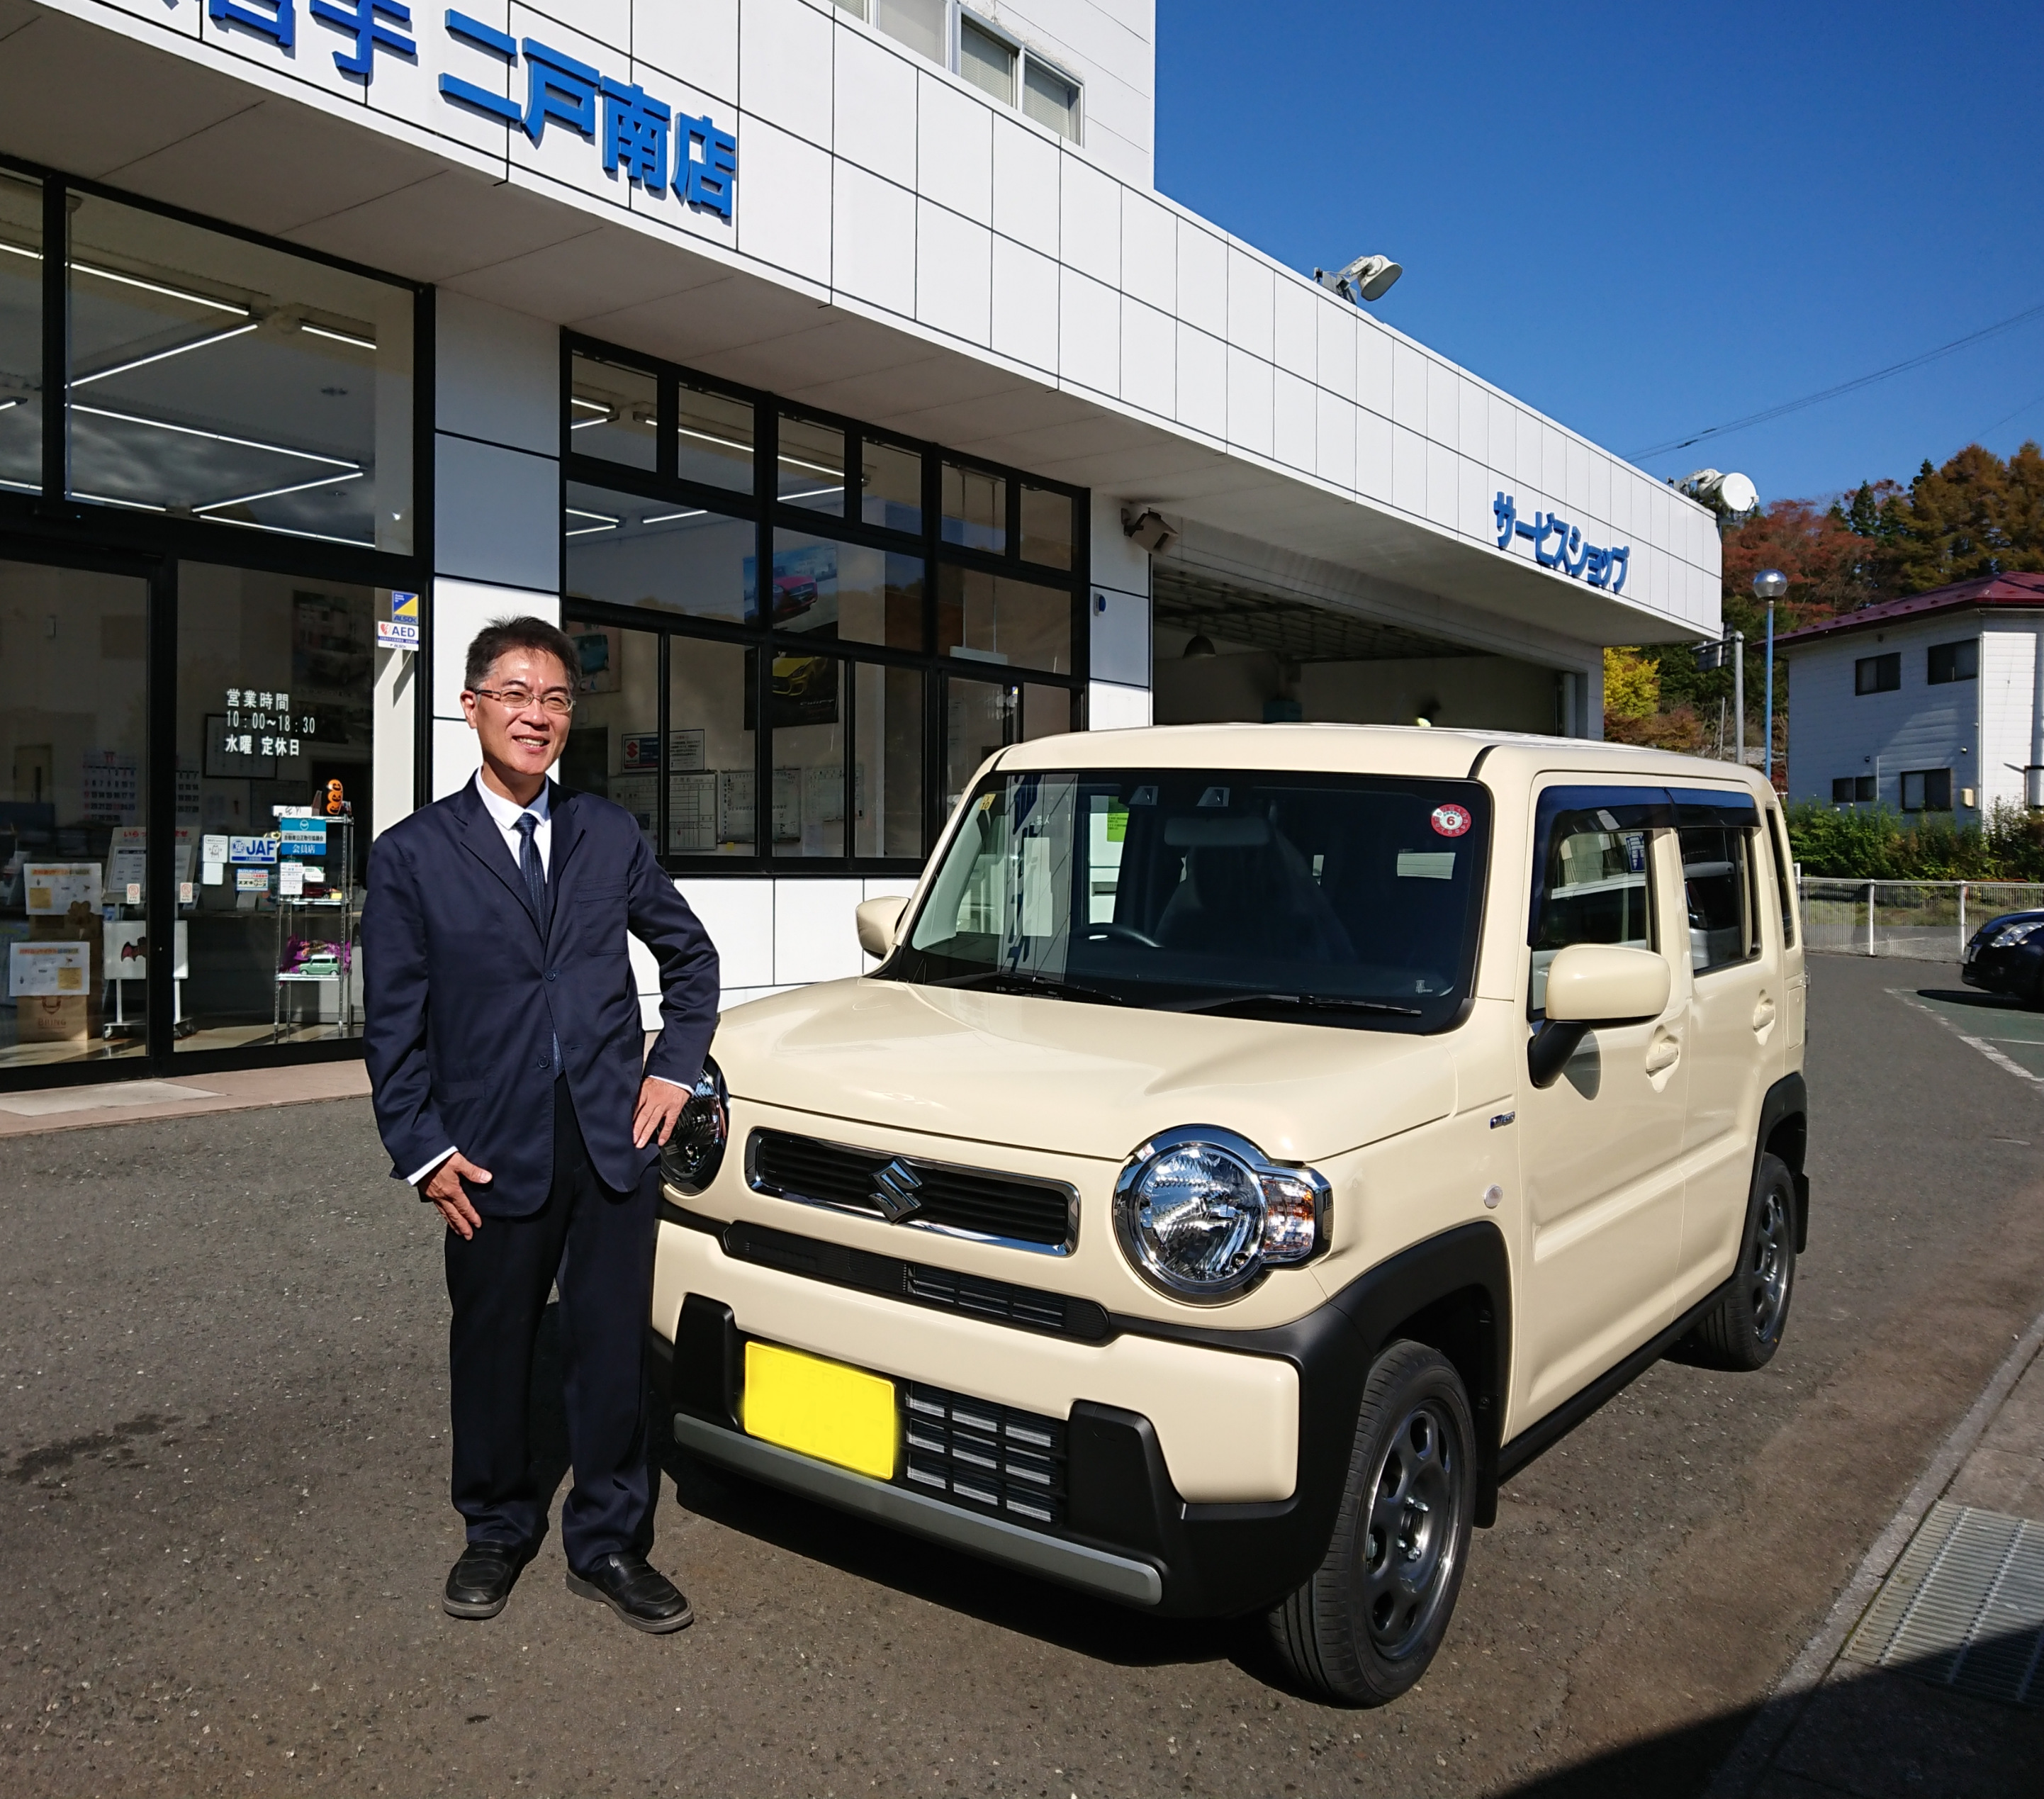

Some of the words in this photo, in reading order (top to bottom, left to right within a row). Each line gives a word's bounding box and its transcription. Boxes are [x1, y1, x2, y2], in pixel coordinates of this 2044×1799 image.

[1493, 491, 1629, 595] サービスショップ
[392, 626, 415, 637] AED
[227, 688, 288, 711] 営業時間
[225, 734, 252, 755] 水曜
[261, 736, 299, 756] 定休日
[1447, 816, 1455, 826] 6
[246, 840, 276, 856] JAF
[292, 844, 315, 854] 会員店
